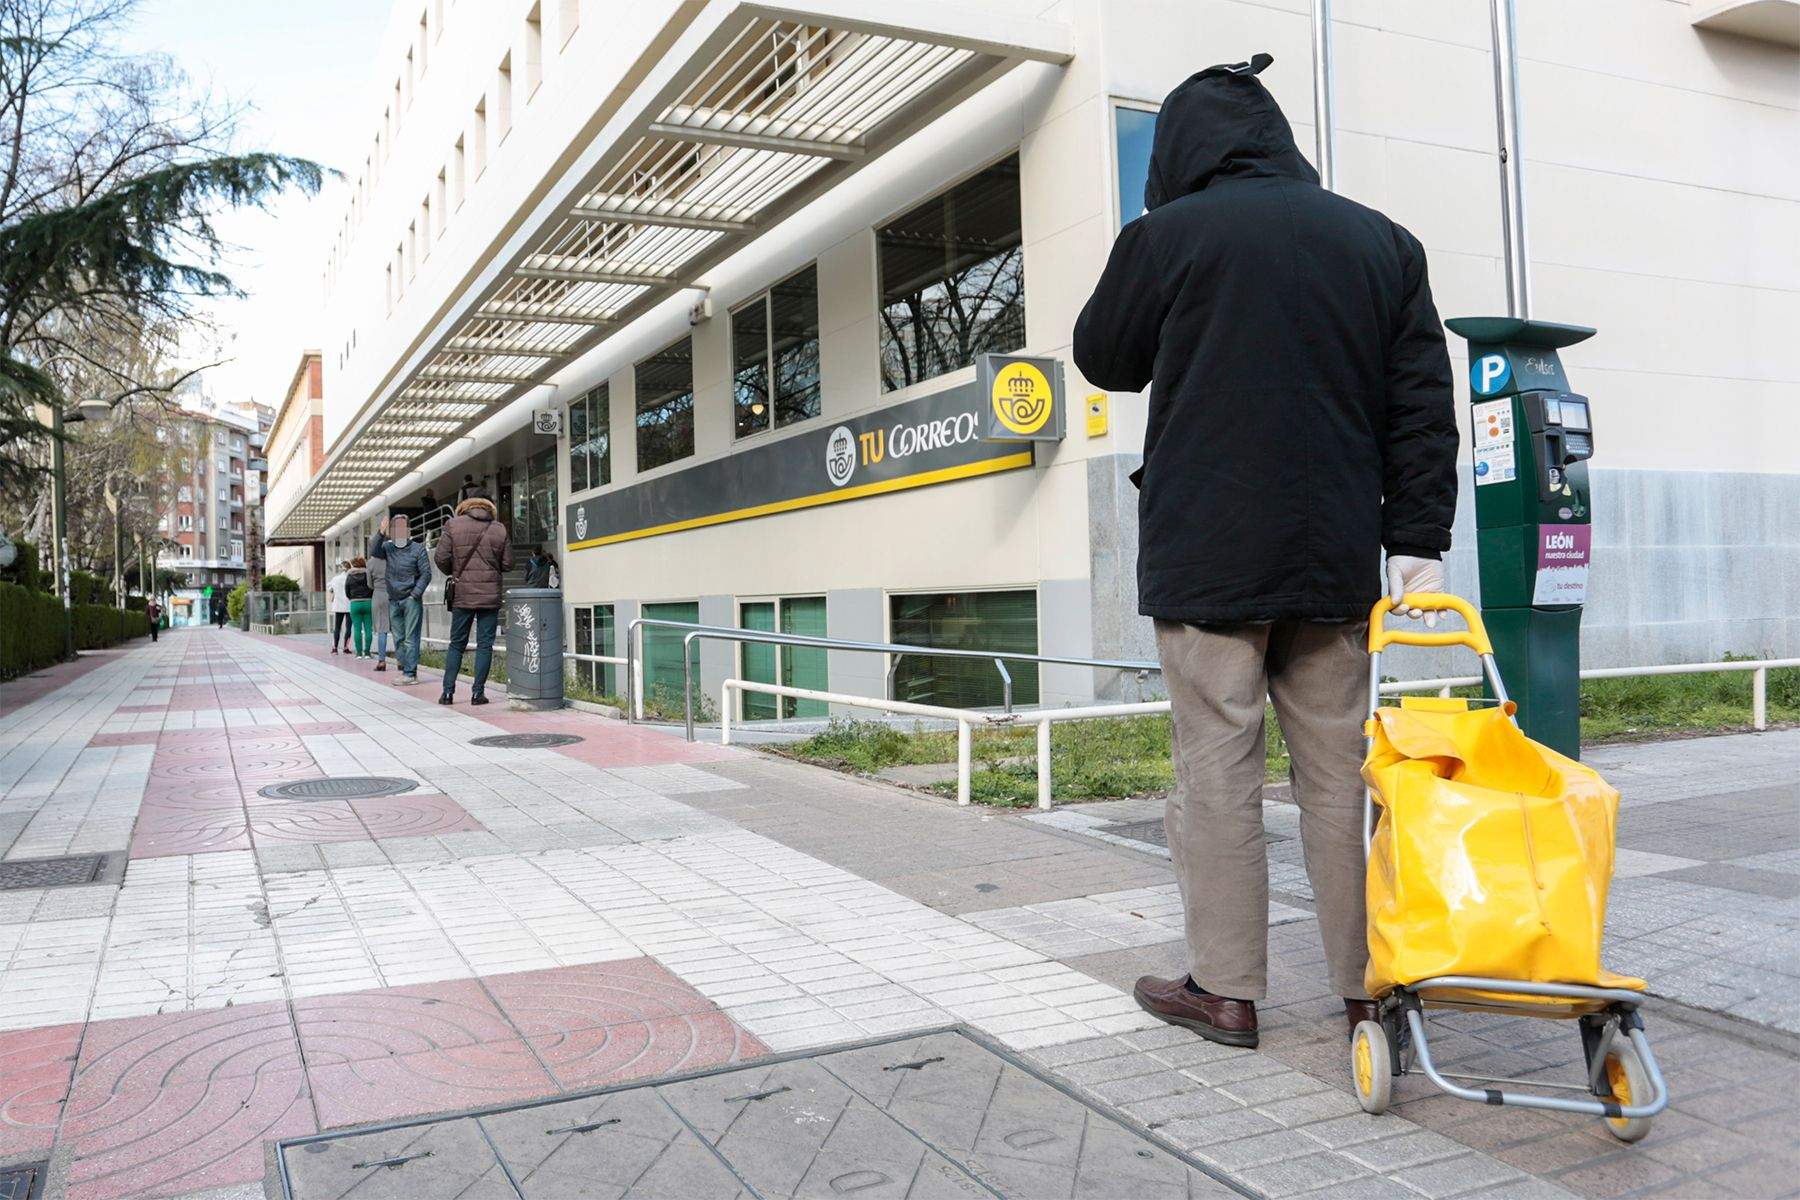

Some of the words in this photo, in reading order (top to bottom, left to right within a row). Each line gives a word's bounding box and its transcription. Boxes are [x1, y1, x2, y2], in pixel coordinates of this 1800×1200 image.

[1482, 355, 1505, 392] P
[859, 428, 885, 466] TU
[1545, 531, 1574, 549] LEÓN
[1545, 551, 1566, 560] nuestra
[1566, 550, 1585, 559] ciudad
[1563, 582, 1584, 590] destino
